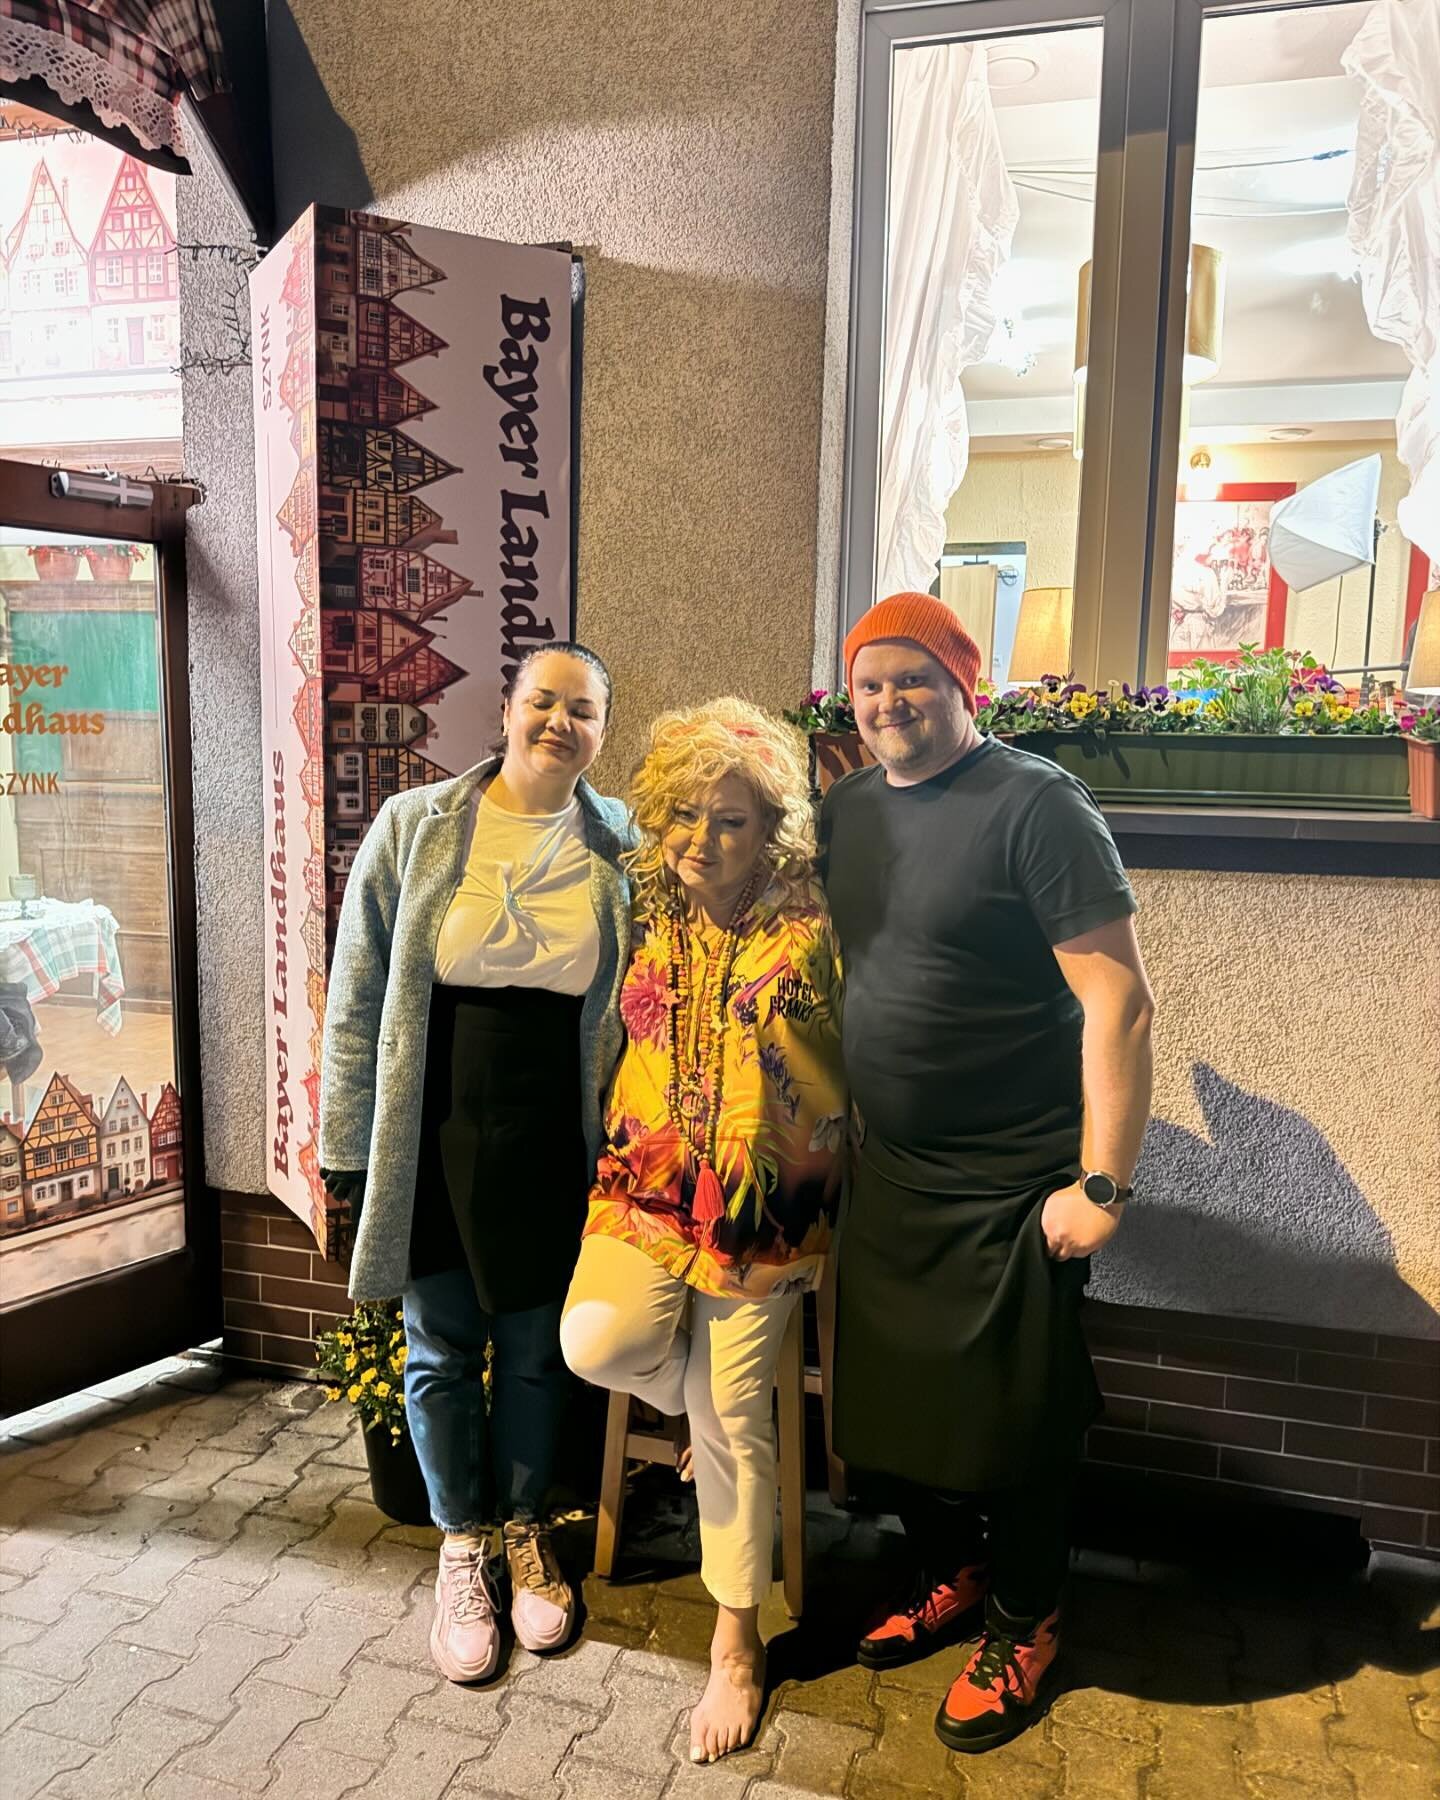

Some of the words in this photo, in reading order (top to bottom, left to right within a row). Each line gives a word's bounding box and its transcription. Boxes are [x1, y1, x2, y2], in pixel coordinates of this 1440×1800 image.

[260, 304, 272, 412] SZYNK
[483, 294, 551, 479] Bayer
[499, 489, 556, 711] Land
[0, 701, 106, 735] dhaus
[270, 750, 288, 1019] Landhaus
[777, 976, 814, 1003] HOTEL
[273, 1025, 294, 1180] Bayer
